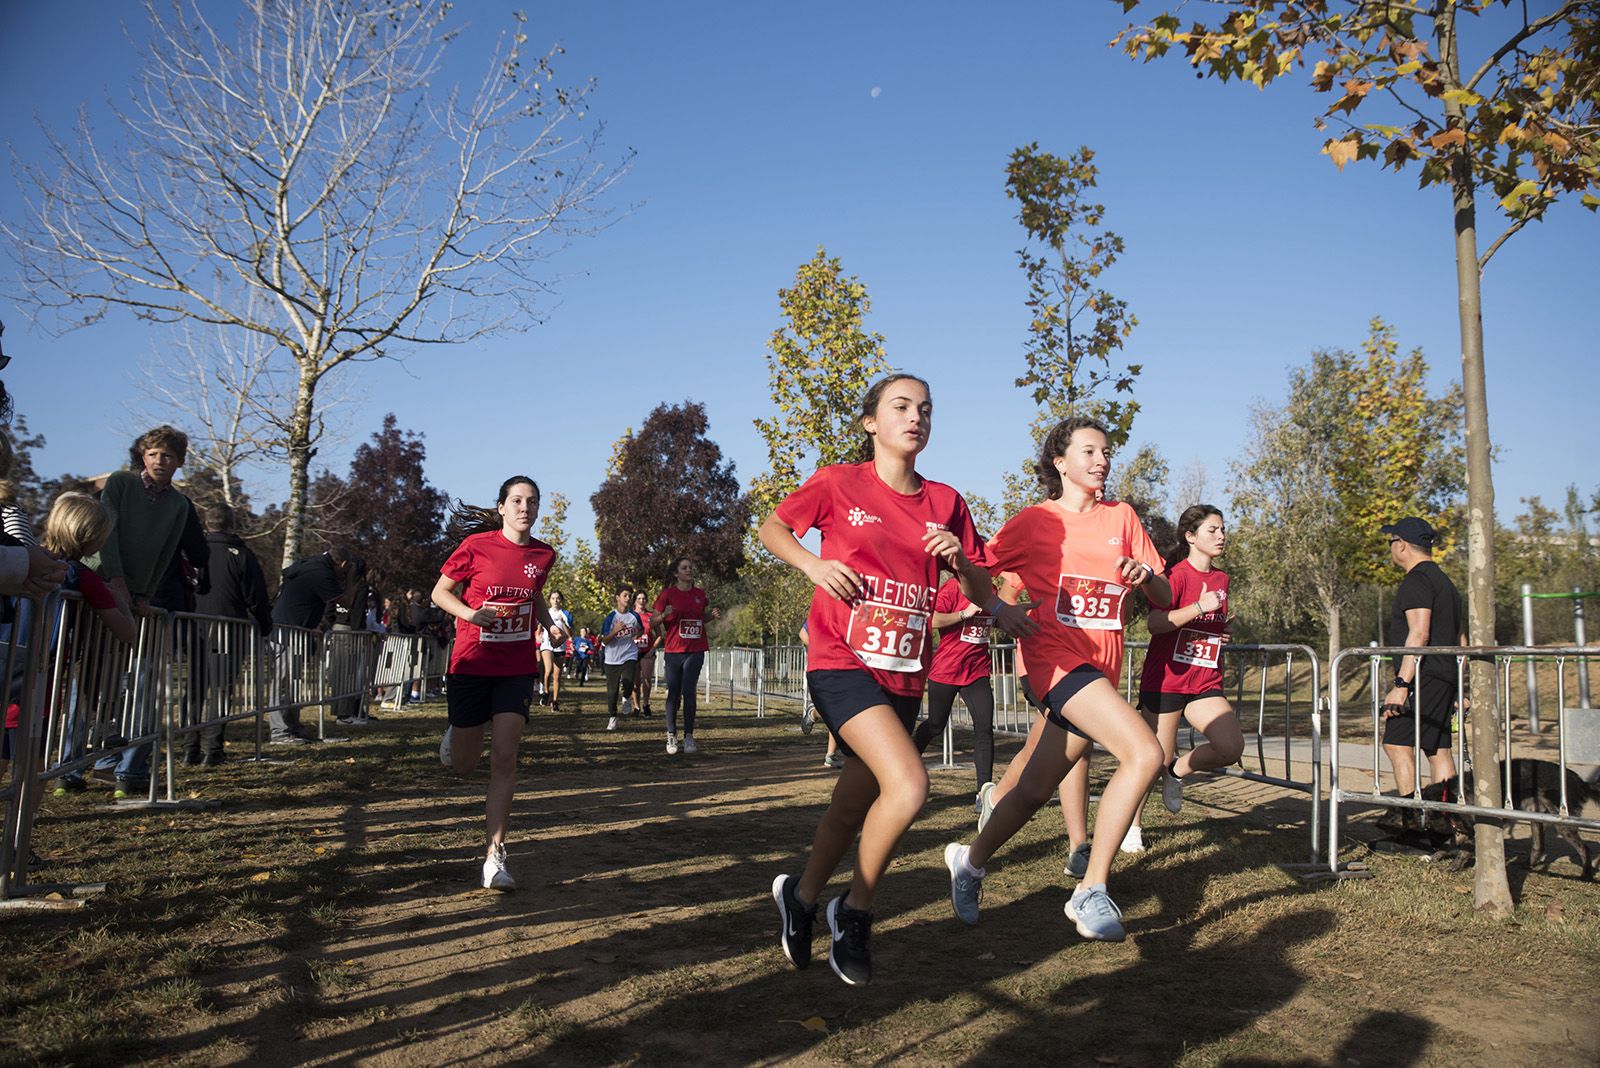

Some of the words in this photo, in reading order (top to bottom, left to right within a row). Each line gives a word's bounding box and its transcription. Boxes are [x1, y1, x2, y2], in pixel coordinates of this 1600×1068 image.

[863, 514, 882, 523] AMPA
[1069, 594, 1111, 617] 935
[491, 617, 525, 633] 312
[684, 626, 700, 634] 709
[969, 626, 989, 637] 336
[862, 626, 914, 657] 316
[1183, 641, 1212, 659] 331
